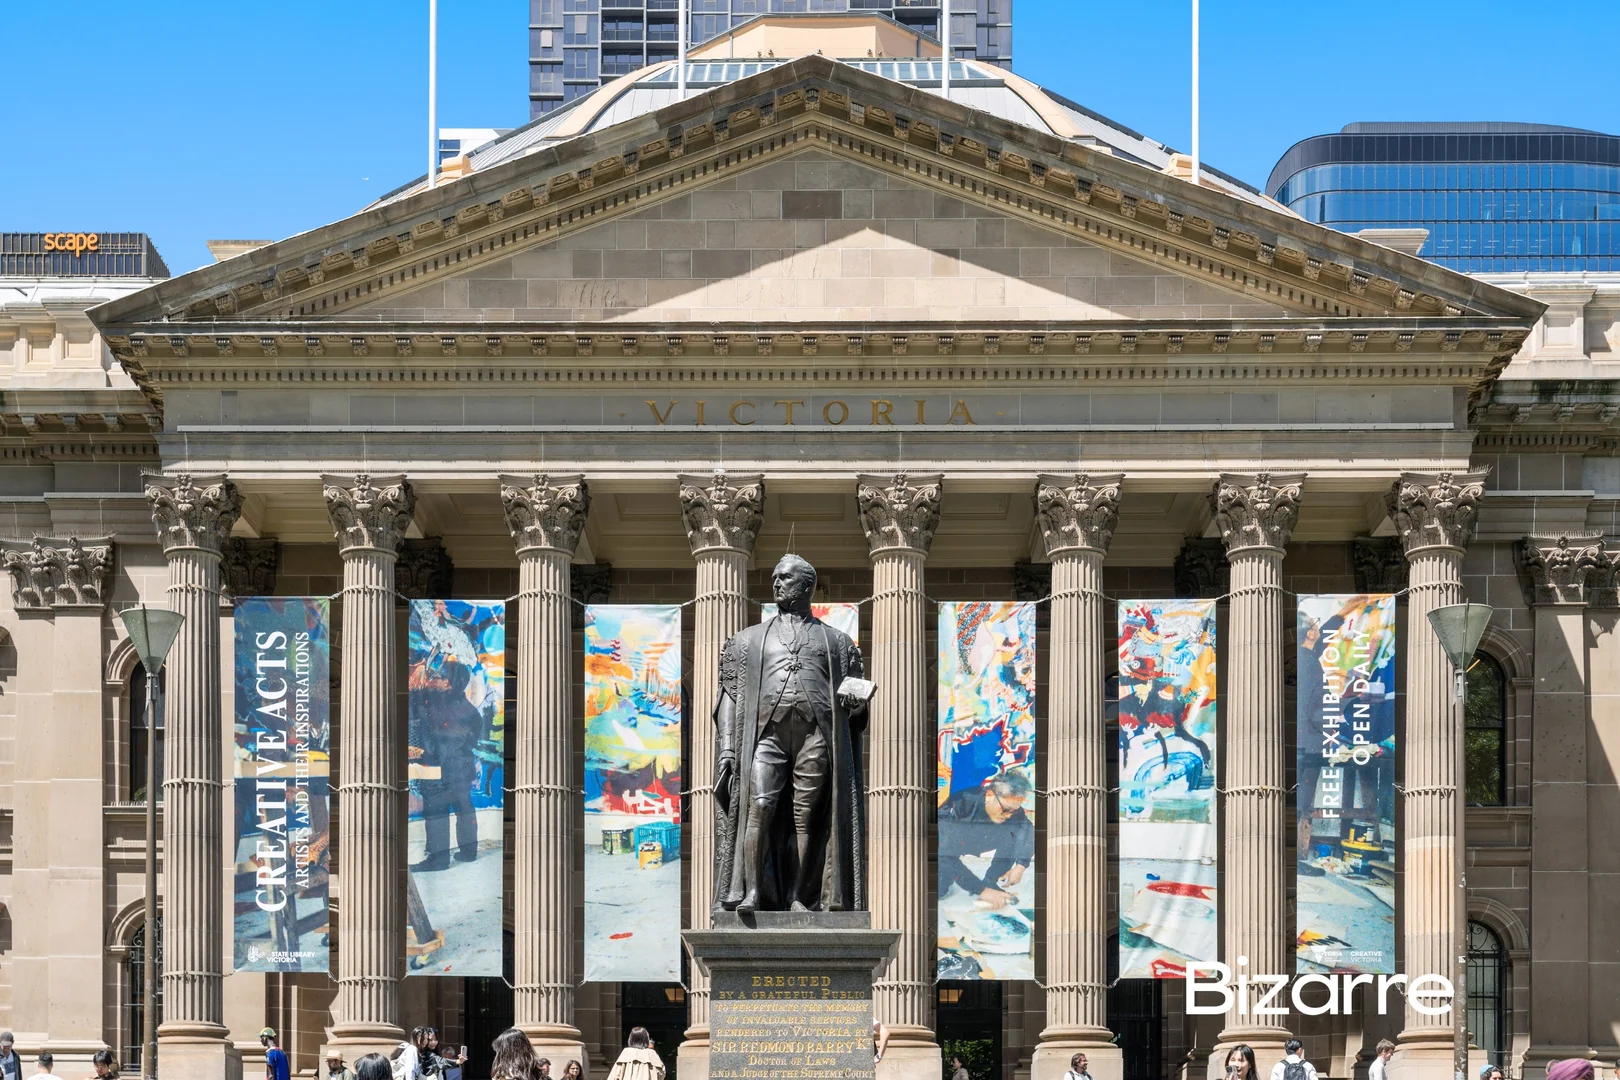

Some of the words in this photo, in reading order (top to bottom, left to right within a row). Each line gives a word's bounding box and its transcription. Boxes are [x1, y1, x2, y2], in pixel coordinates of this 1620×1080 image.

[44, 233, 98, 258] scape
[644, 400, 978, 426] VICTORIA
[255, 630, 288, 722] ACTS
[1352, 628, 1371, 694] DAILY
[295, 631, 310, 738] INSPIRATIONS
[1322, 629, 1341, 758] EXHIBITION
[1352, 703, 1371, 766] OPEN
[295, 743, 310, 789] THEIR
[295, 791, 310, 825] AND
[1322, 768, 1341, 819] FREE
[255, 729, 288, 912] CREATIVE
[295, 827, 310, 889] ARTISTS
[719, 991, 735, 999] BY
[737, 991, 747, 999] A
[751, 991, 816, 999] GRATEFUL
[751, 976, 831, 987] ERECTED
[715, 1003, 729, 1012] TO
[731, 1003, 799, 1012] PERPETUATE
[801, 1003, 823, 1012] THE
[825, 1003, 868, 1012] MEMORY
[726, 1016, 738, 1025] OF
[741, 1016, 806, 1025] INVALUABLE
[809, 1016, 858, 1025] SERVICES
[710, 1041, 737, 1053] SIR
[739, 1041, 805, 1053] REDMOND
[805, 1041, 854, 1053] BARRY
[716, 1028, 772, 1037] RENDERED
[775, 1028, 789, 1037] TO
[855, 1028, 868, 1037] BY
